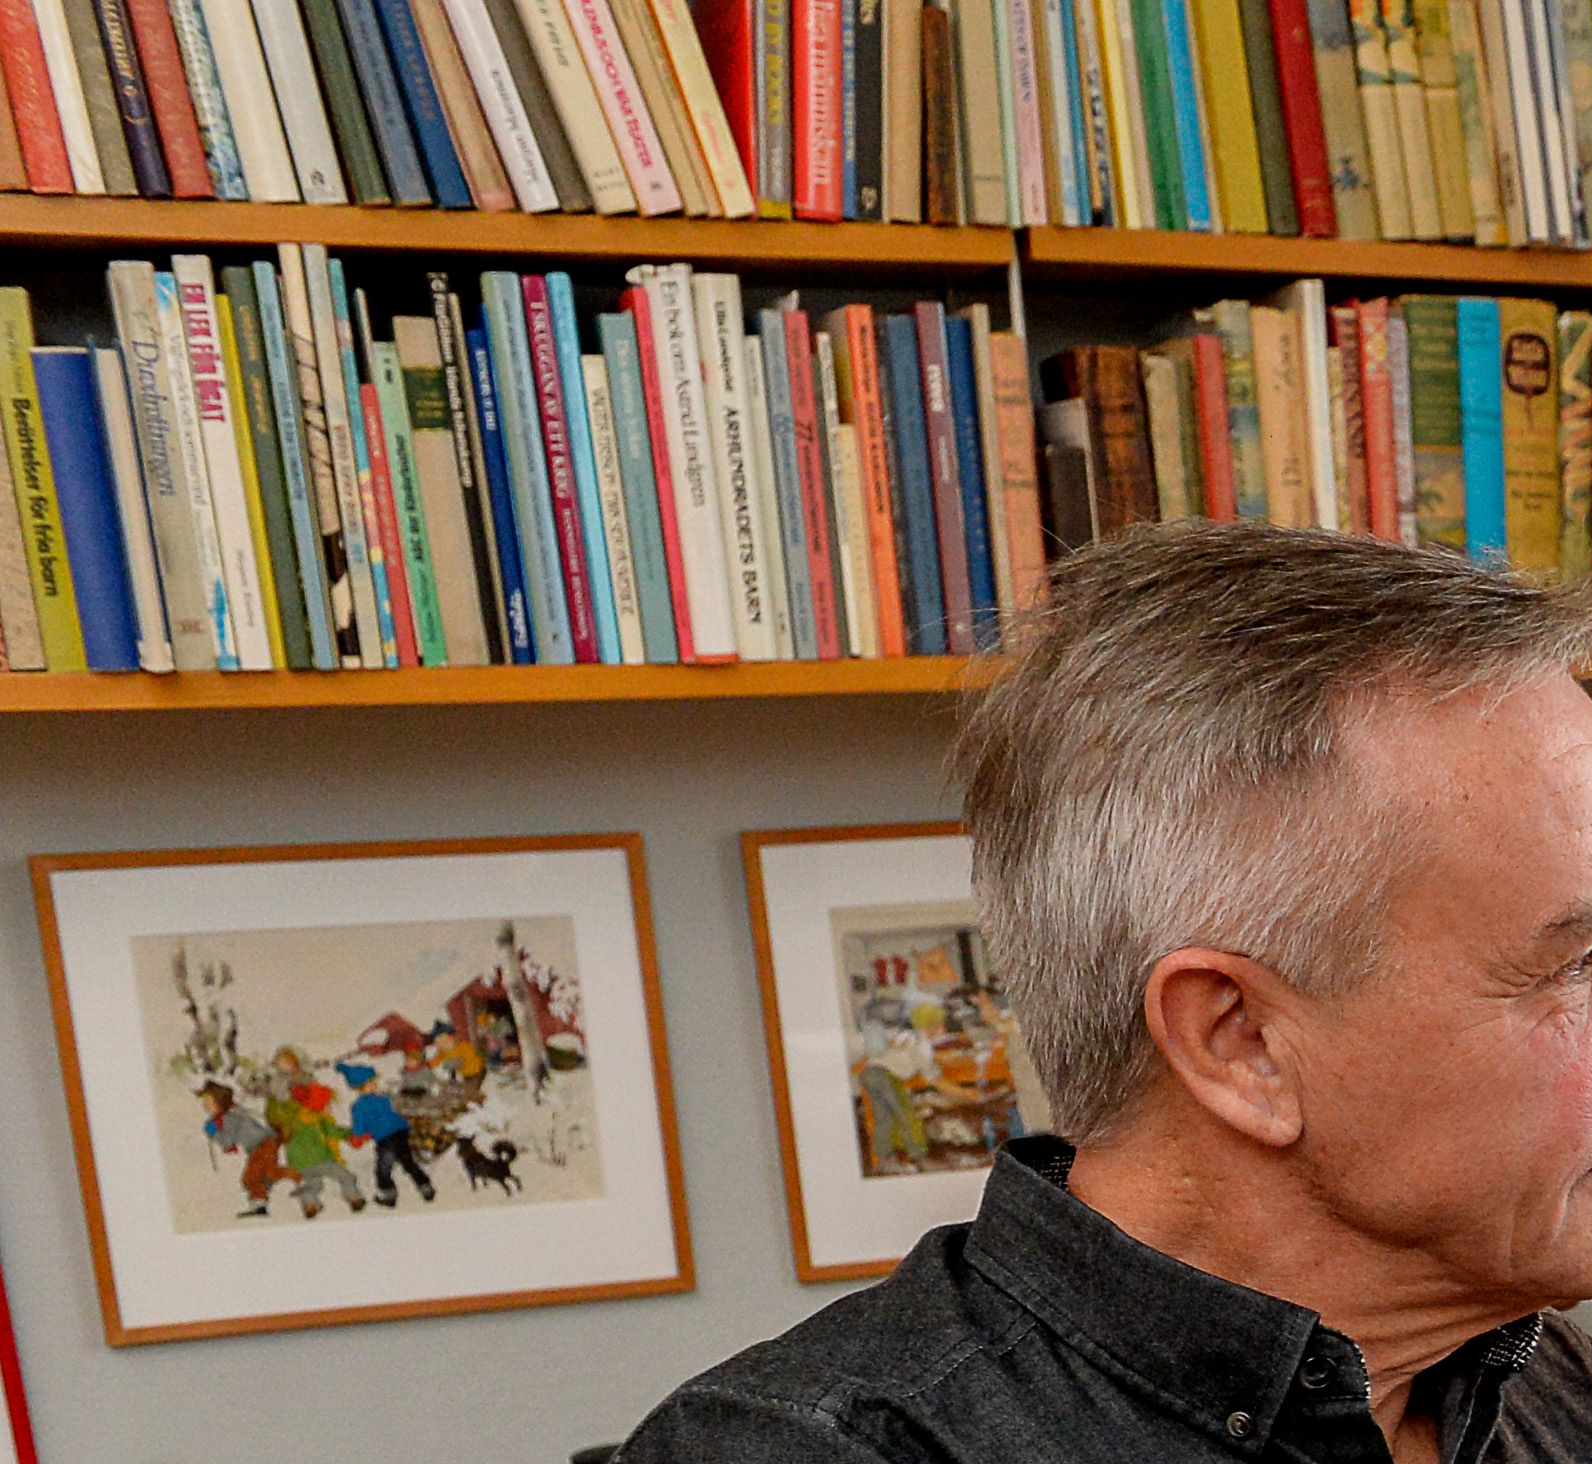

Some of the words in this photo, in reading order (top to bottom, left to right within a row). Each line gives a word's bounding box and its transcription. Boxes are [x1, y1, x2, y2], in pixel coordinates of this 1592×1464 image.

[181, 283, 208, 305] EN
[660, 281, 680, 306] En
[186, 309, 215, 337] LEK
[666, 309, 687, 341] bok
[531, 311, 555, 393] SKUGGAN
[669, 343, 688, 373] om
[541, 396, 558, 416] AV
[672, 377, 696, 428] Astrid
[11, 399, 40, 490] Berättelser
[545, 420, 563, 449] ETT
[679, 430, 707, 507] Lindgren
[23, 496, 47, 520] för
[31, 524, 53, 554] fria
[37, 556, 60, 596] barn
[742, 570, 762, 624] BARN
